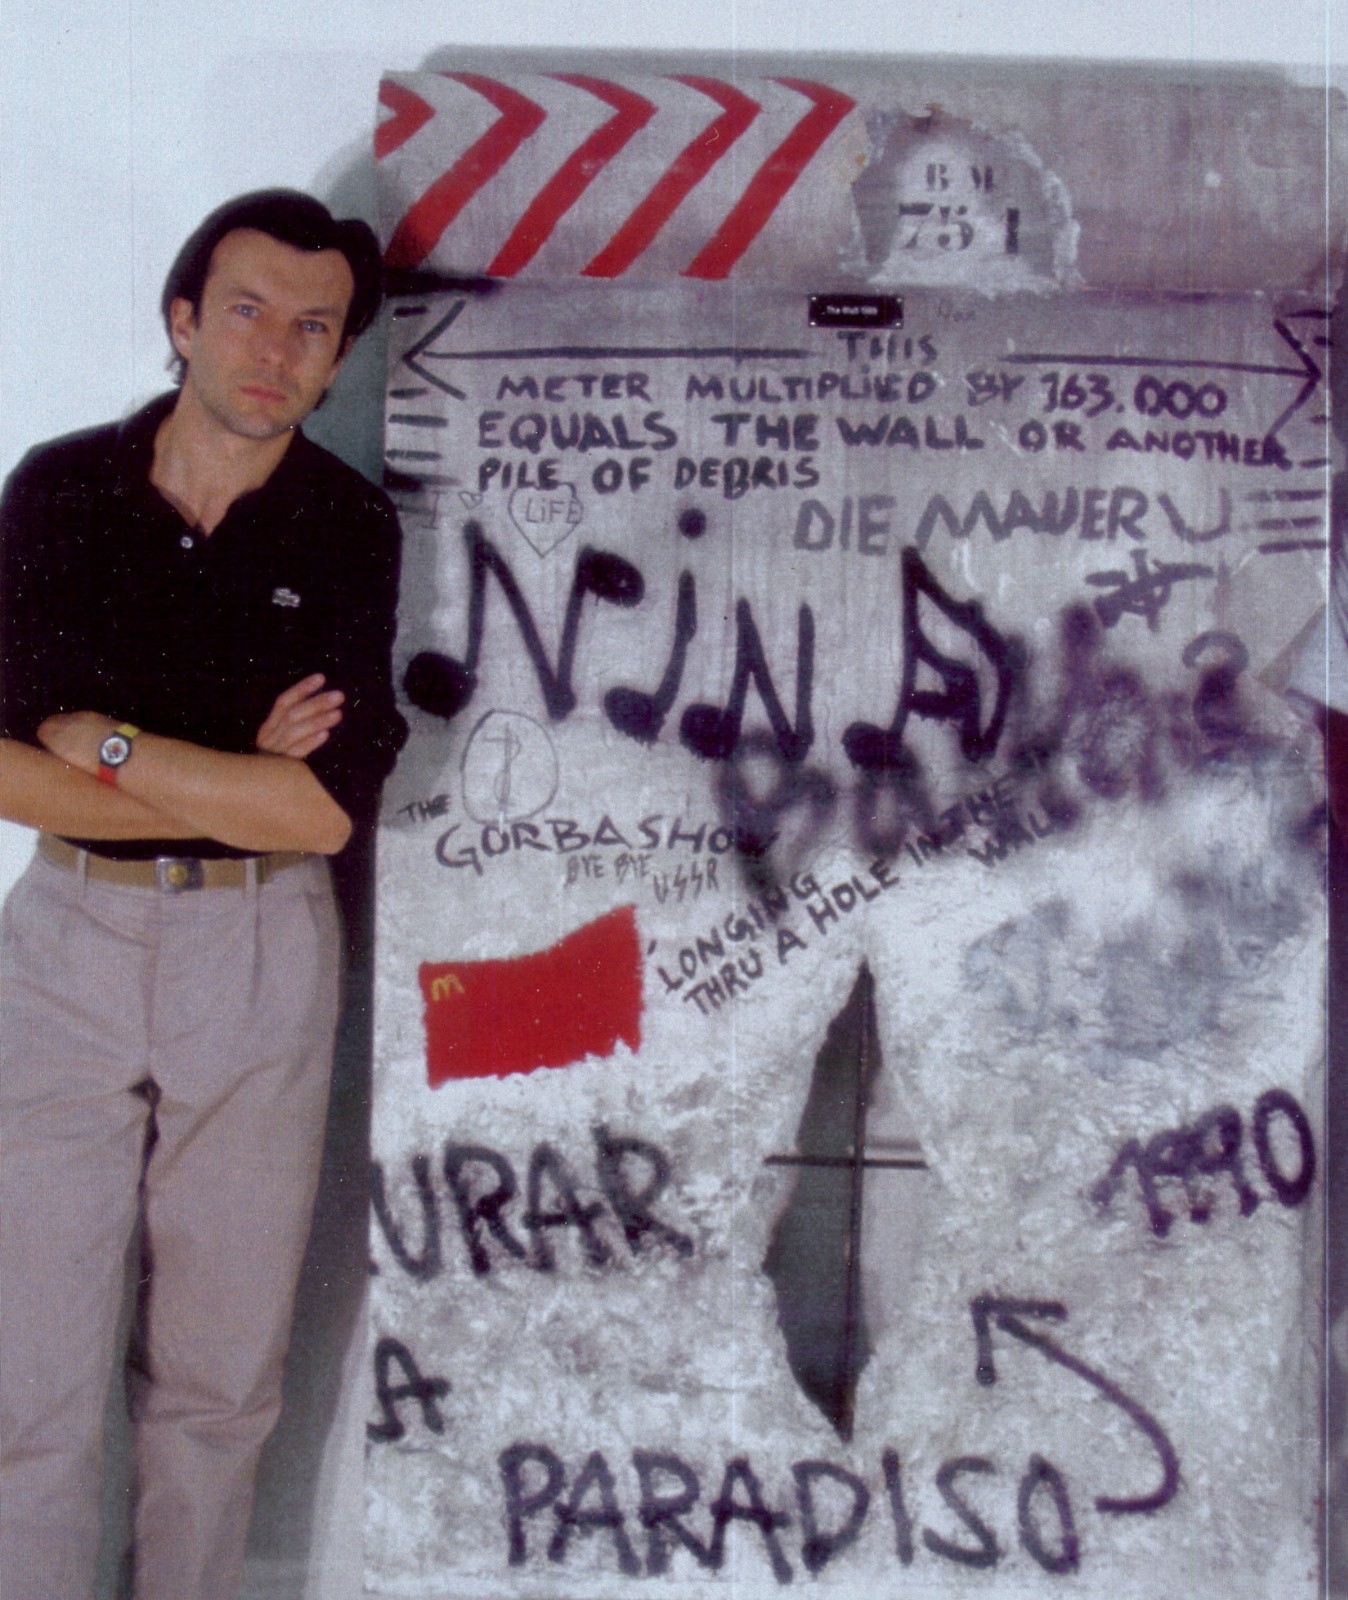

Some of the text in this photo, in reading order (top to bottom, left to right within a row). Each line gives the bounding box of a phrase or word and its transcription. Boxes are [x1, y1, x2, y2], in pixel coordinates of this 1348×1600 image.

[836, 329, 939, 367] THIS
[500, 374, 652, 402] METER
[966, 374, 1025, 408] BY
[478, 411, 1294, 472] EQUALS THE WALL OR ANOTHER
[478, 457, 821, 500] PILE OF DEBRIS
[795, 496, 896, 556] DIE
[915, 484, 1150, 550] MAUER
[398, 793, 450, 824] THE
[683, 948, 764, 1015] THRU
[775, 926, 809, 966] A
[805, 858, 901, 936] HOLE
[499, 1443, 1082, 1585] PARADISO
